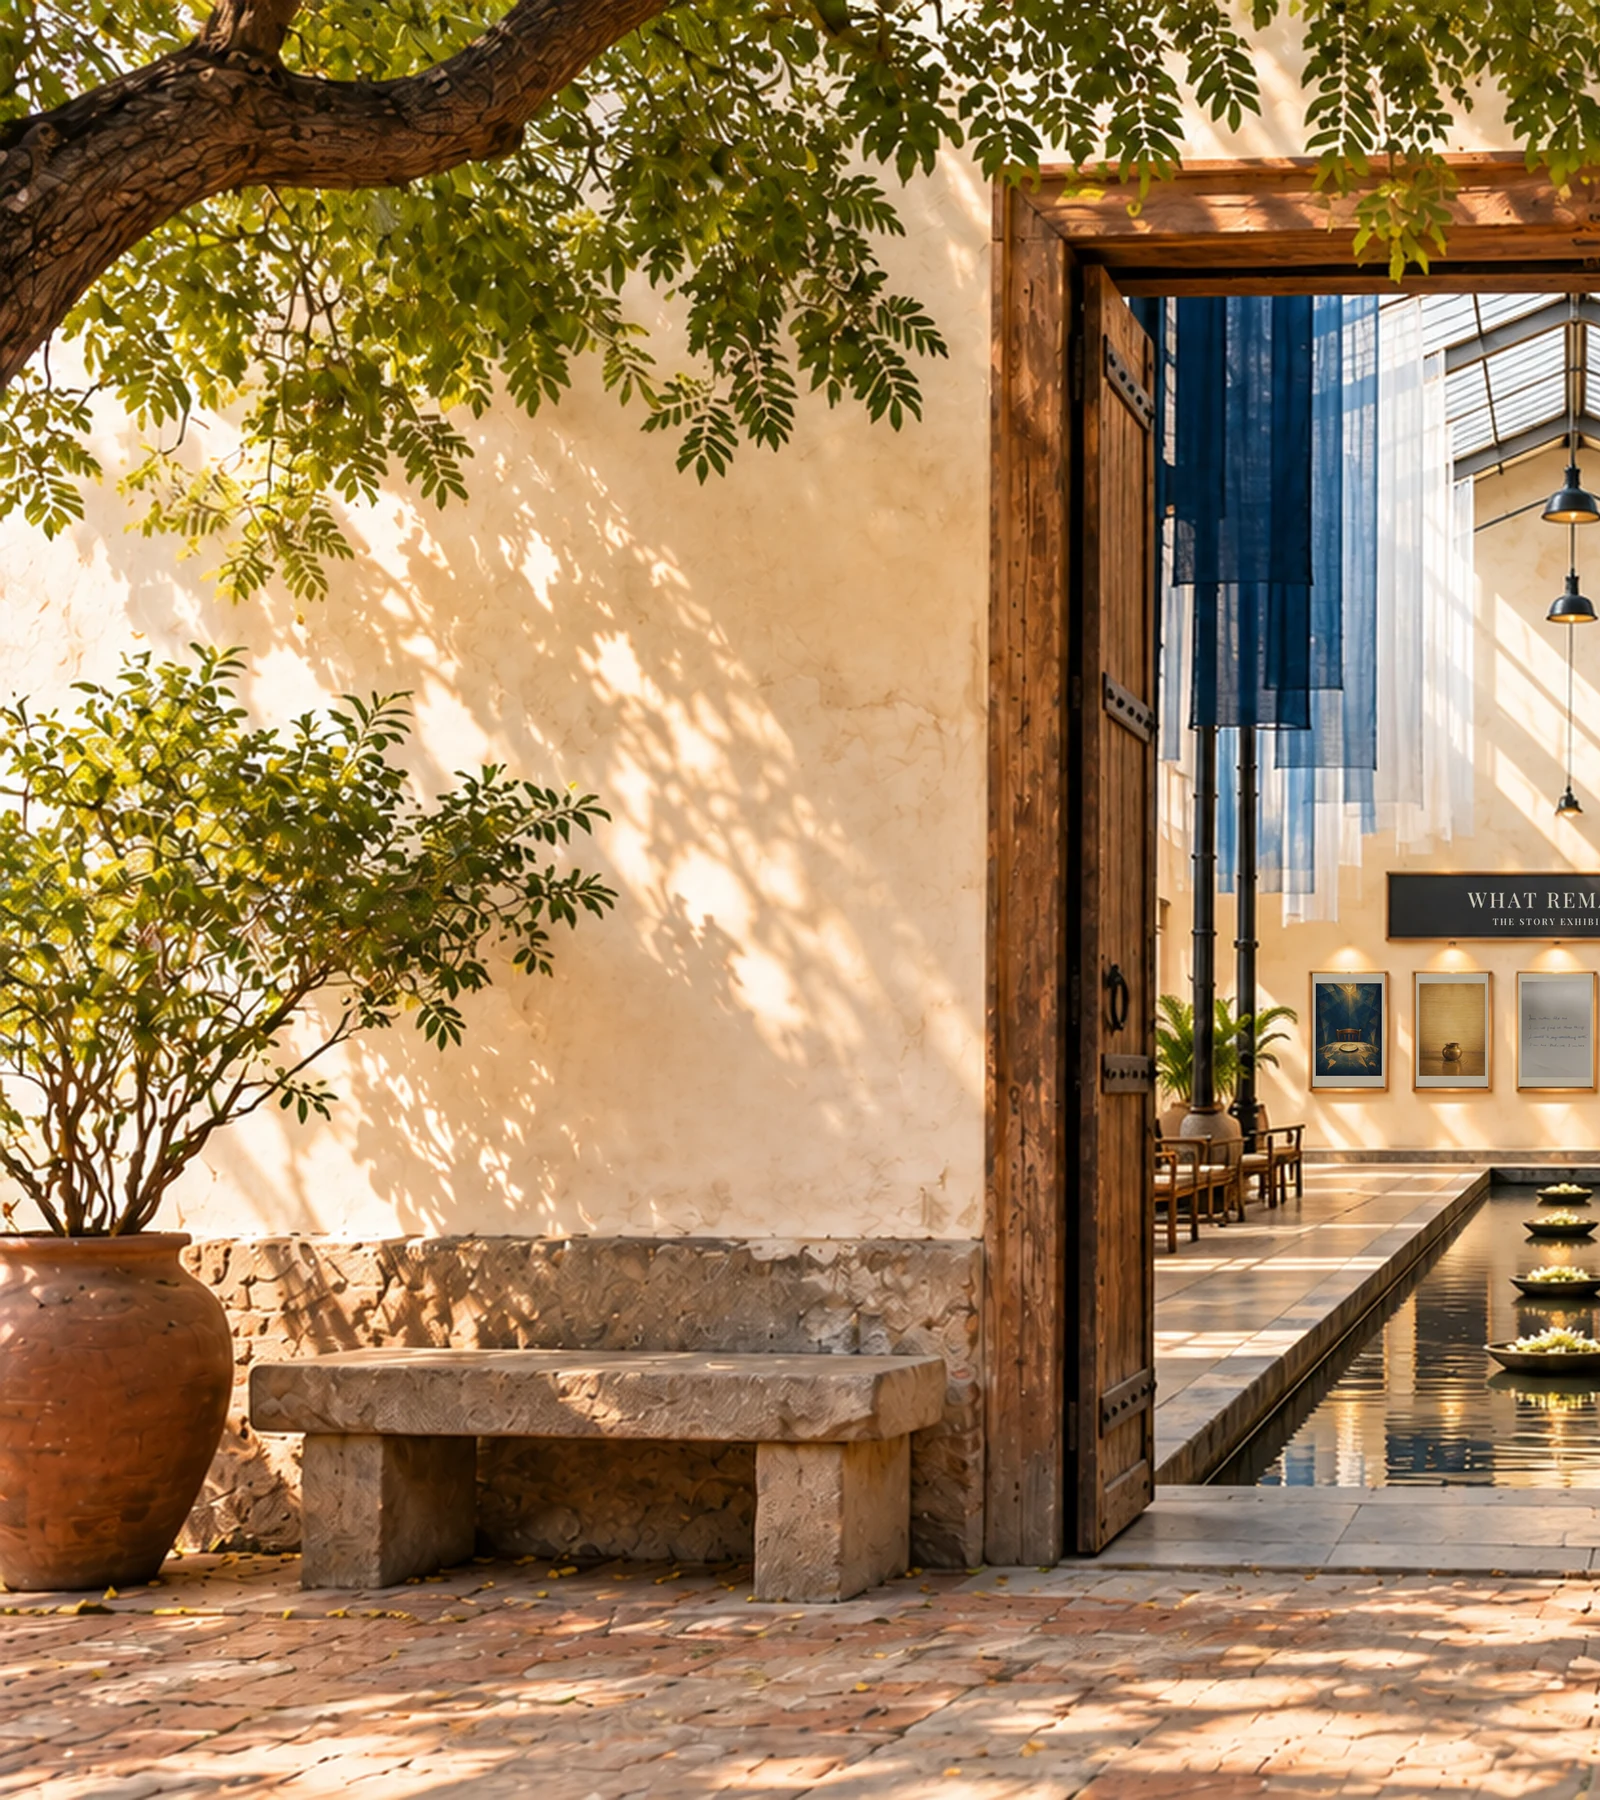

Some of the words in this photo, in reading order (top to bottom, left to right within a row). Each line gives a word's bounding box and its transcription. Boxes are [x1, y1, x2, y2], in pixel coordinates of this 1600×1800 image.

[1467, 891, 1537, 909] WHAT
[1492, 917, 1515, 926] THE
[1519, 917, 1556, 926] STORY
